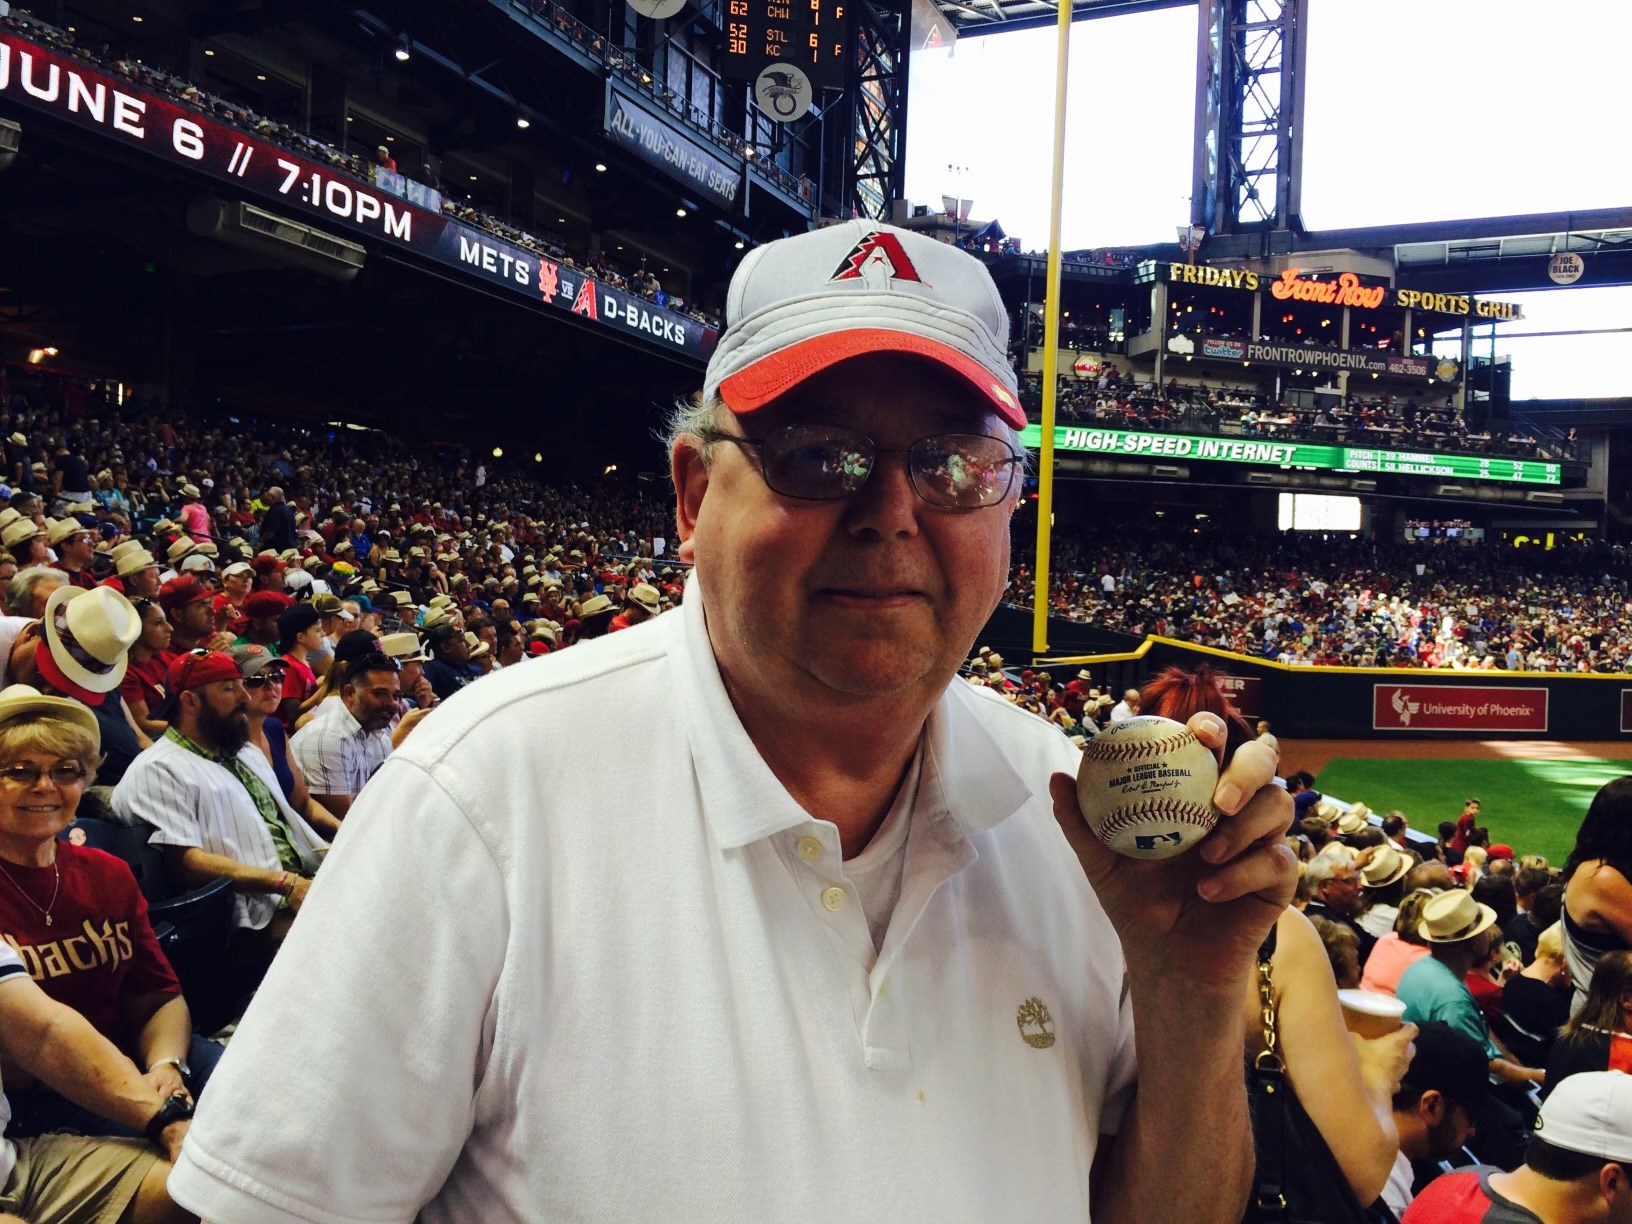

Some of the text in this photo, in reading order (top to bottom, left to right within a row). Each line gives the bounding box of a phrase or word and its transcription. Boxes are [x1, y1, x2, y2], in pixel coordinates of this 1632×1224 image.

[730, 1, 748, 16] 62
[836, 7, 844, 19] F
[729, 23, 818, 48] 52 STL 6
[729, 39, 747, 54] 30
[765, 44, 781, 56] KC
[834, 45, 842, 56] F
[172, 118, 205, 161] 6
[277, 158, 412, 242] 7:10PM
[708, 169, 737, 201] SEATS
[1552, 265, 1580, 274] BLACK
[1560, 256, 1574, 265] JOE
[459, 236, 530, 286] METS
[604, 295, 685, 346] D-BACKS
[1170, 262, 1259, 291] FRIDAY'S
[1271, 266, 1338, 305] Front
[1334, 272, 1385, 309] Row
[1397, 288, 1470, 315] SPORTS
[1203, 344, 1244, 359] twitter
[1389, 363, 1427, 376] 462-3506
[1063, 430, 1297, 463] HIGH-SPEED INTERNET
[1346, 459, 1378, 470] COUNTS
[1398, 463, 1454, 476] HELLICKSON
[1350, 449, 1373, 460] PITCH
[1400, 452, 1435, 464] HAMMEL
[1512, 461, 1524, 471] 52
[1423, 703, 1531, 719] University of Phoenix
[1134, 763, 1161, 772] OFFICIAL
[1108, 769, 1192, 788] MAJOR LEAGUE BASEBALL
